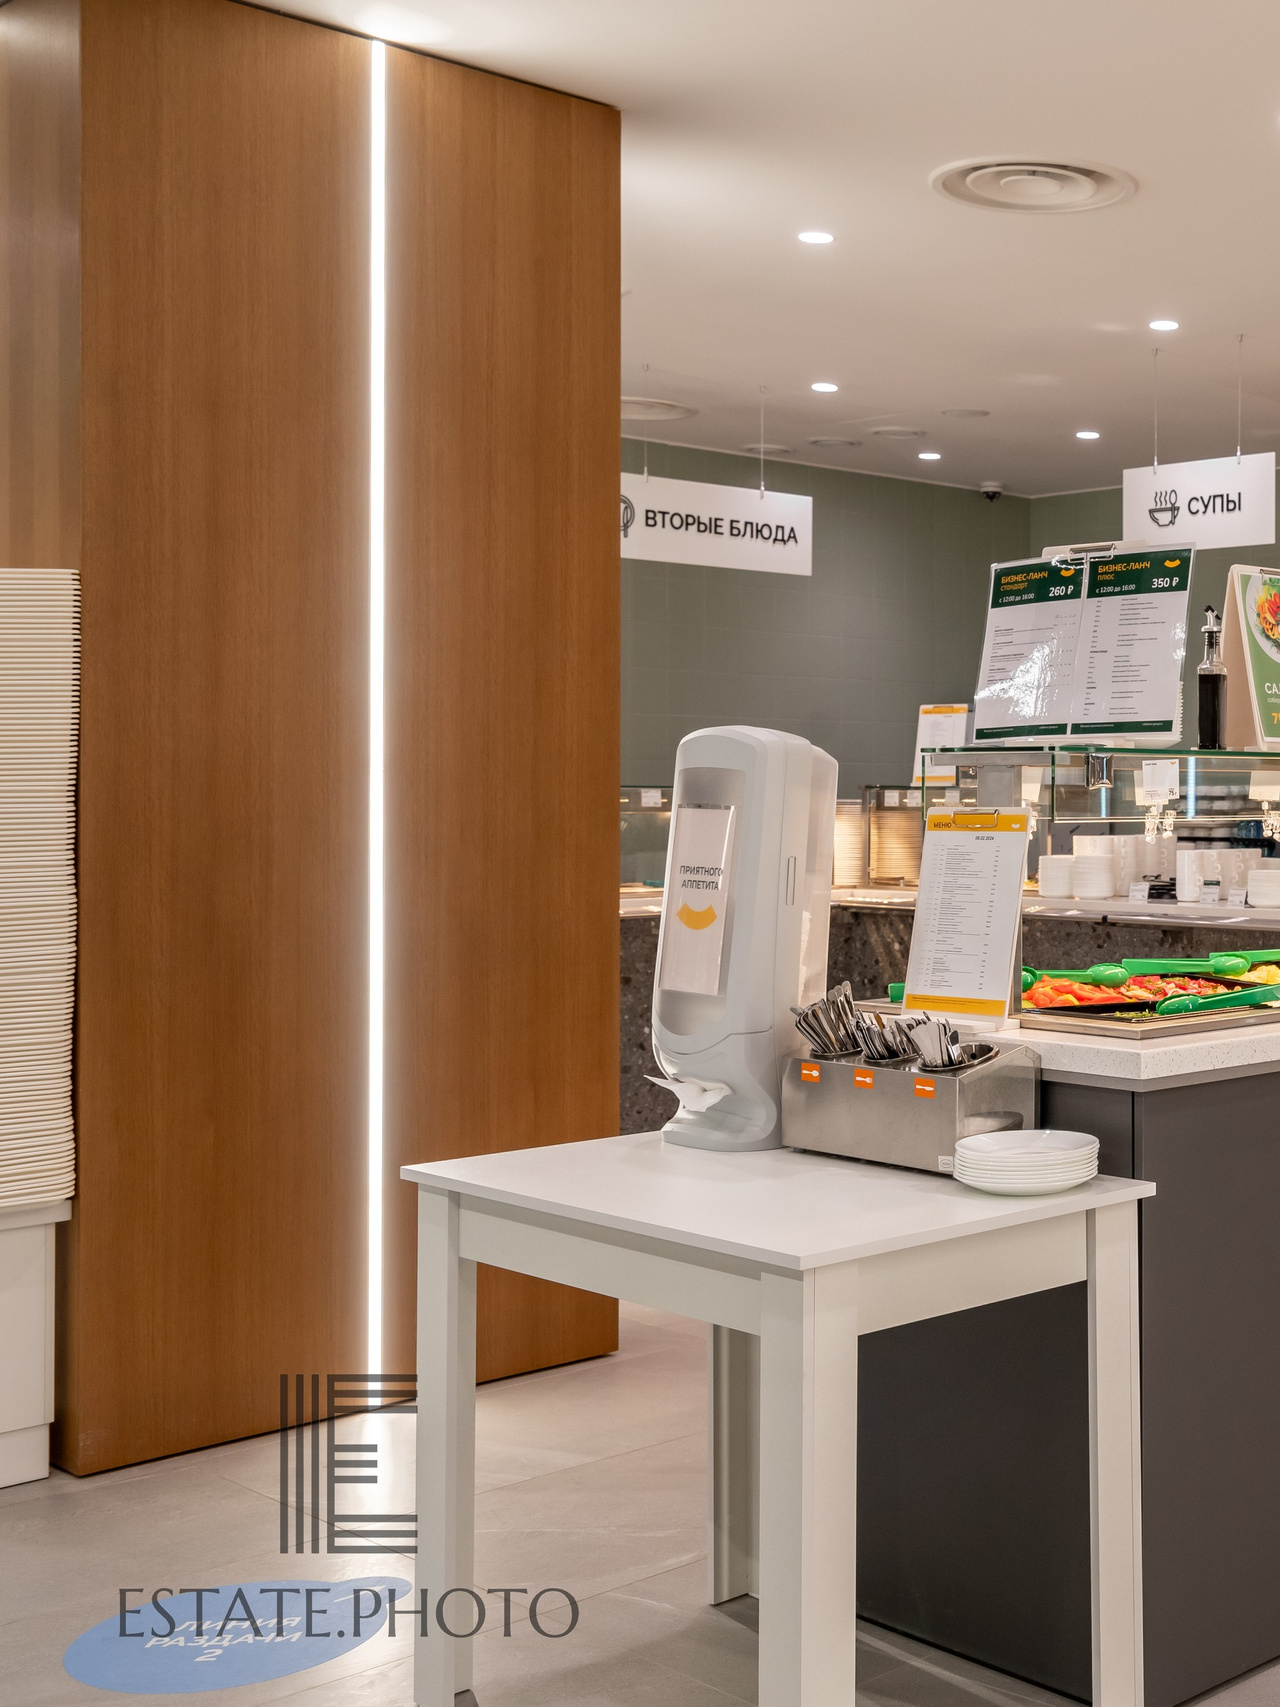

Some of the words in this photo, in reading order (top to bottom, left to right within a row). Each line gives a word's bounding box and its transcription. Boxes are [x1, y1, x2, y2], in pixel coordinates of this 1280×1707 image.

[1187, 491, 1242, 515] СУПЫ
[644, 509, 725, 536] ВТОРЫЕ
[729, 519, 799, 546] БЛЮДА
[1098, 561, 1151, 573] БИЗНЕС-ЛАНЧ
[1000, 570, 1049, 584] БИЗНЕС-ЛАНЧ
[1151, 577, 1170, 588] 350
[1048, 585, 1066, 597] 260
[933, 821, 952, 829] МЕНЮ
[679, 865, 723, 877] ПРИЯТНОГО
[681, 879, 719, 891] АППЕТИТА
[174, 1615, 303, 1633] ЛИНИЯ
[143, 1631, 303, 1649] РАЗДАЧИ
[194, 1648, 222, 1662] 2
